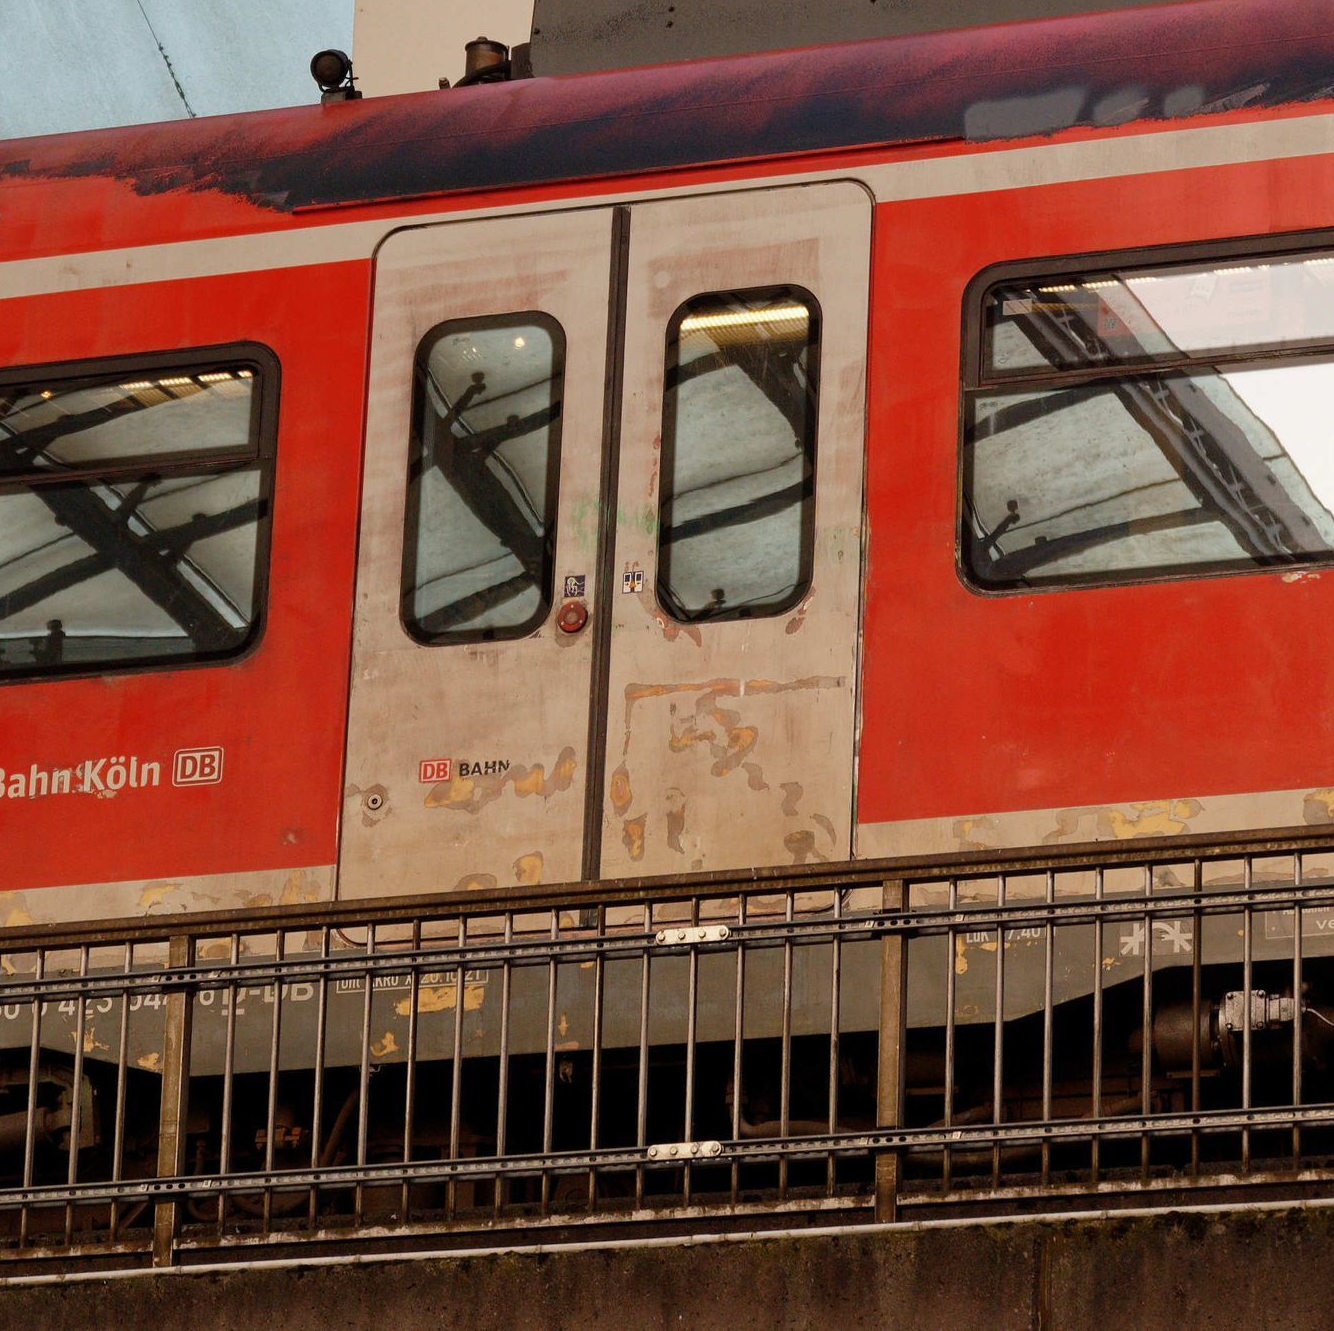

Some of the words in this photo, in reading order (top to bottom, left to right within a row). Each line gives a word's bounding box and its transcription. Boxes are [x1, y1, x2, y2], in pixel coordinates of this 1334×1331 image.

[82, 755, 161, 793] Köln
[179, 753, 217, 781] DB
[422, 762, 449, 781] DB
[458, 759, 510, 778] BAHN
